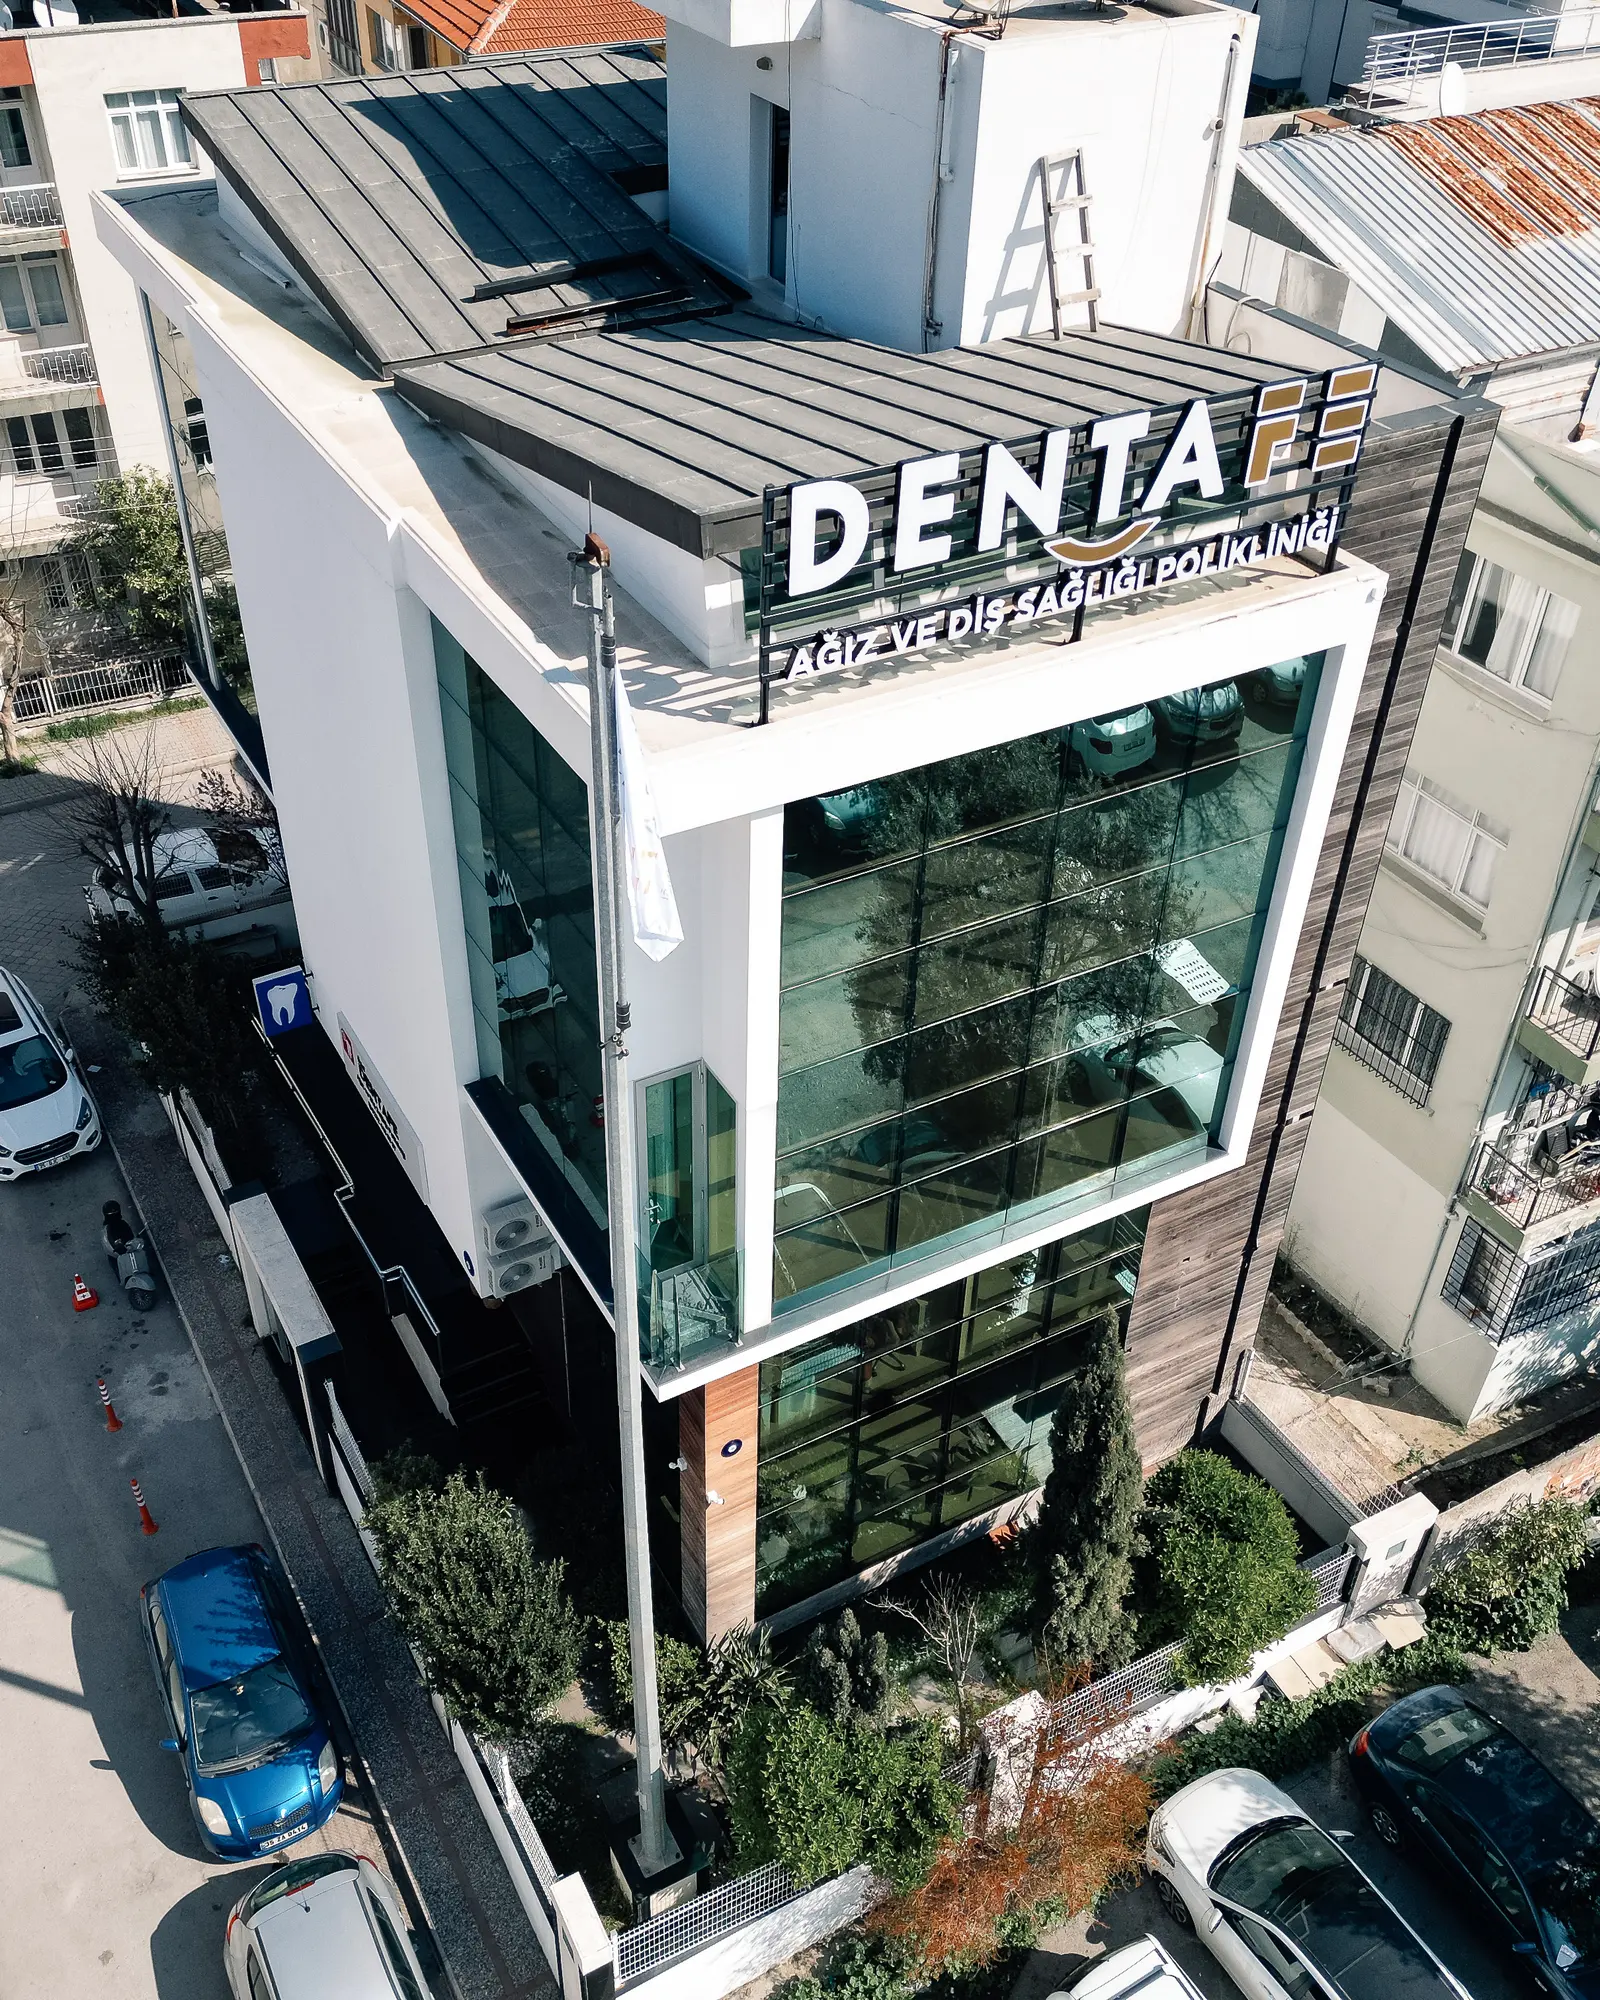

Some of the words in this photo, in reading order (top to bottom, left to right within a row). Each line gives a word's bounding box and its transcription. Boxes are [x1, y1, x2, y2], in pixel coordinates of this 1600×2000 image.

[787, 363, 1378, 597] DENTAFE
[787, 630, 880, 681] AĞIZ
[890, 614, 938, 653] VE
[948, 588, 1006, 641] DİŞ
[1016, 557, 1147, 621] SAĞLIĞI
[1155, 506, 1340, 586] POLİKLİNİĞİ
